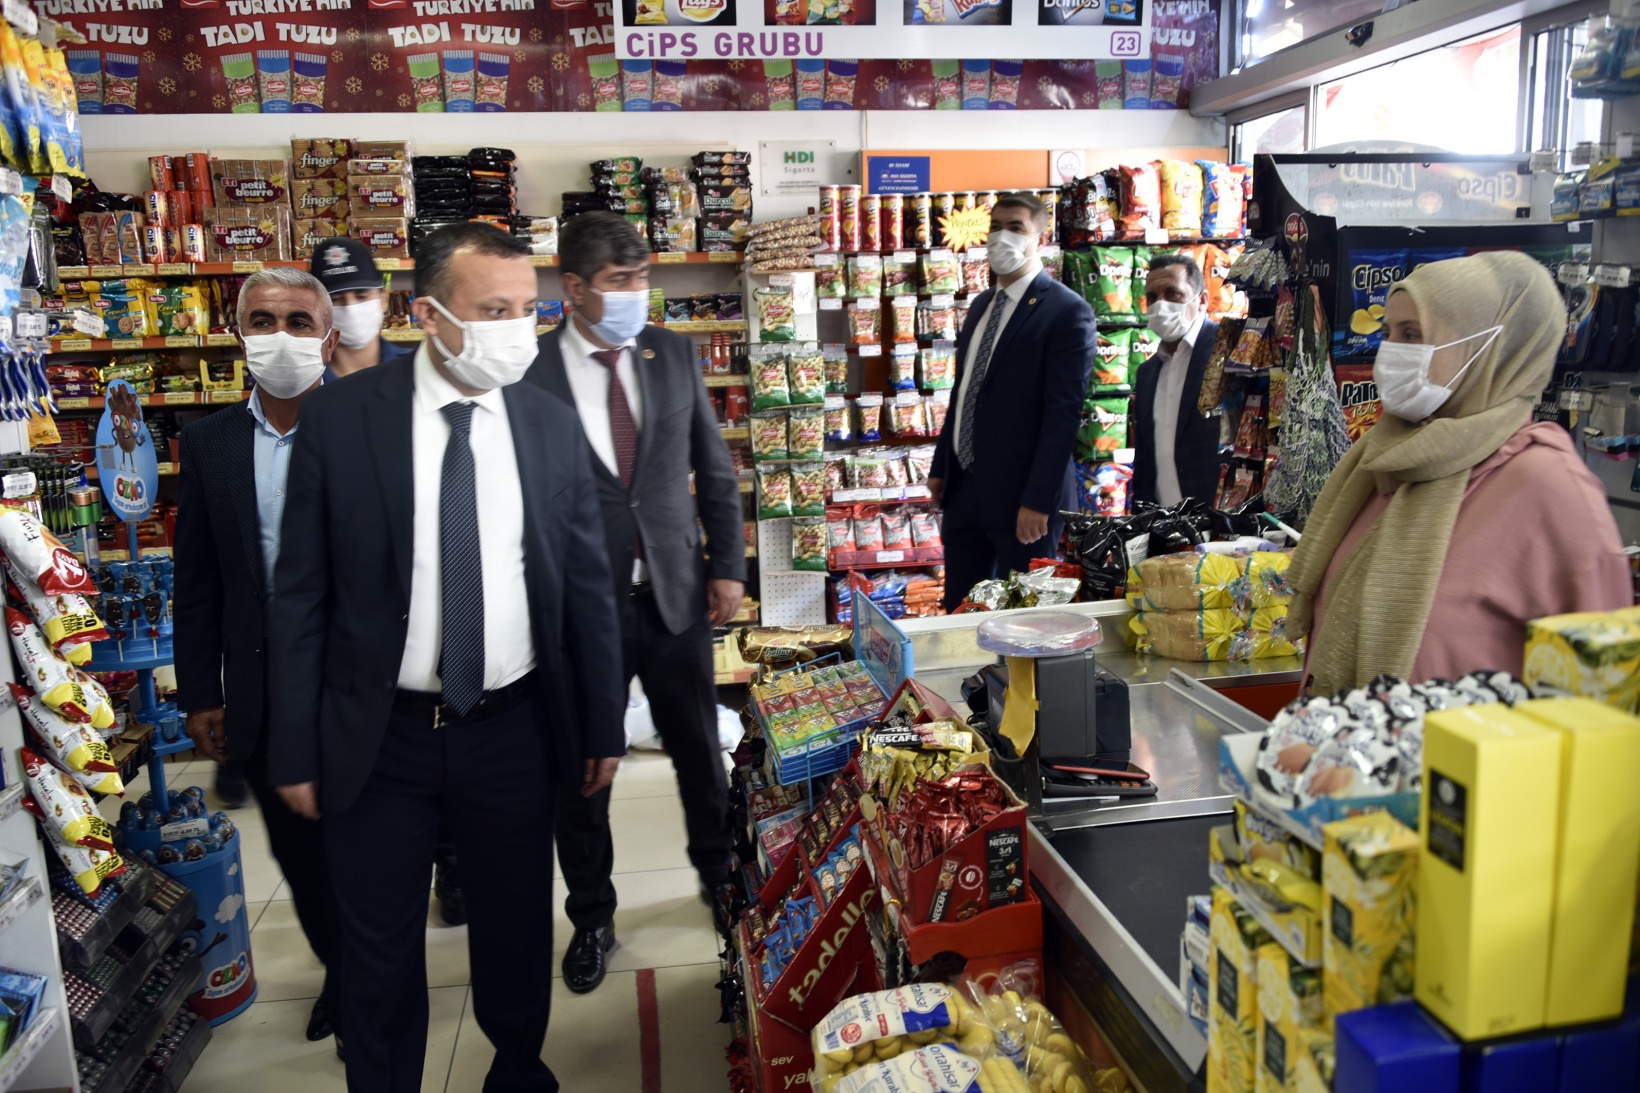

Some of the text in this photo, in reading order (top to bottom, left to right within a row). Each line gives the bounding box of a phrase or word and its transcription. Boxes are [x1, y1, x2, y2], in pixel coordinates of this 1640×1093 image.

[86, 22, 149, 45] TUZU
[200, 21, 338, 47] TADI TUZU
[388, 21, 521, 47] TADI TUZU
[569, 24, 614, 47] TAD
[714, 32, 824, 56] GRUBU
[1116, 36, 1137, 51] 23
[300, 152, 339, 168] finger
[784, 151, 814, 163] HDI
[235, 189, 274, 197] beurre
[241, 181, 266, 191] petit
[300, 193, 339, 209] finger
[704, 196, 735, 206] Burçak
[225, 235, 264, 244] beurre
[231, 228, 257, 237] petit
[703, 228, 734, 238] Burçak
[301, 233, 328, 249] fin
[1352, 264, 1401, 294] Cipso
[116, 477, 144, 501] OZMO
[54, 550, 80, 568] DAYS
[765, 647, 792, 658] halley
[910, 984, 928, 1009] rtahisar
[770, 1055, 795, 1066] sev
[930, 1046, 961, 1089] ortahisar
[783, 1067, 812, 1090] yal
[881, 1070, 901, 1093] Kurab
